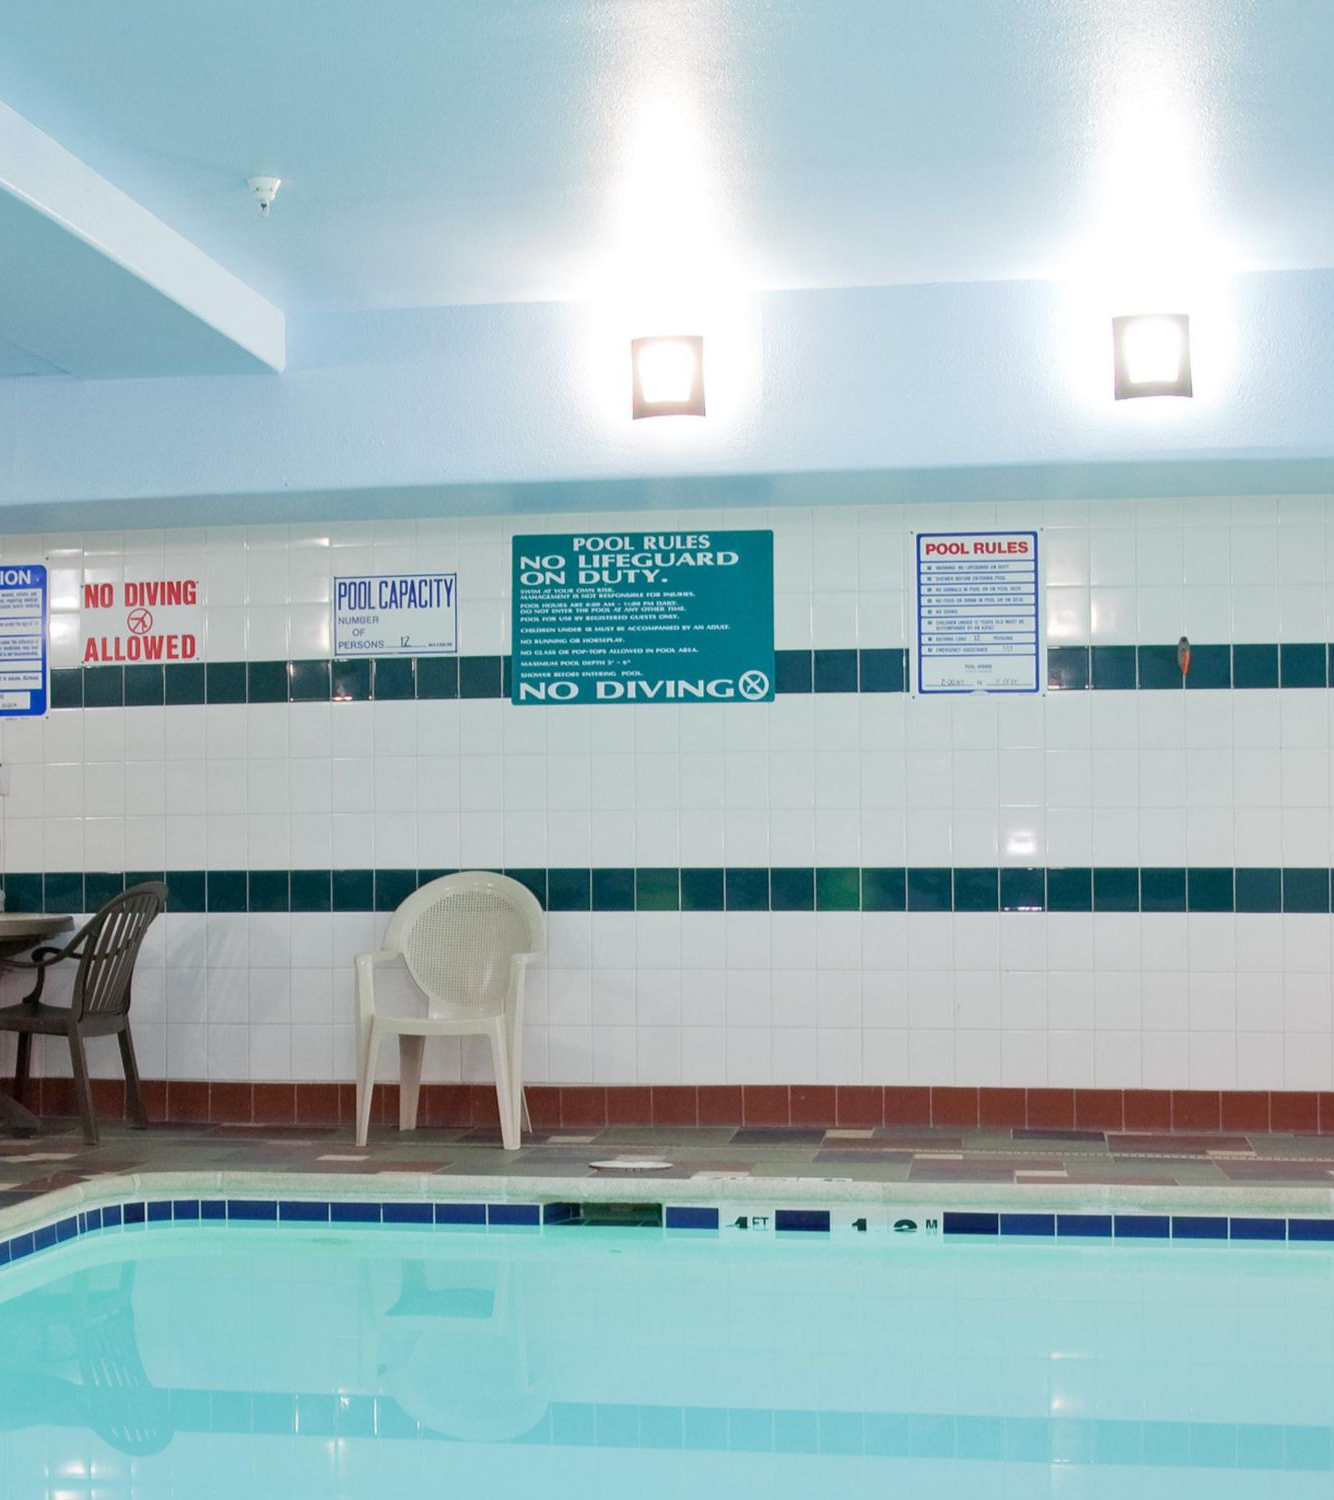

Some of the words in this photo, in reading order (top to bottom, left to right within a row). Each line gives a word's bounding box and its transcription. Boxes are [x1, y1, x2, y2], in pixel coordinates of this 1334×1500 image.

[573, 536, 635, 551] POOL
[643, 534, 710, 550] RULES
[926, 543, 969, 555] POOL
[974, 541, 1029, 554] RULES
[520, 555, 565, 570] NO
[579, 551, 739, 569] LIFEGUARD
[520, 571, 565, 586] ON
[579, 569, 667, 585] DUTY.
[85, 583, 113, 608] NO
[125, 580, 196, 607] DIVING
[338, 581, 376, 611] POOL
[379, 578, 453, 609] CAPACITY
[338, 616, 379, 625] NUMBER
[352, 628, 366, 637] OF
[84, 634, 196, 662] ALLOWED
[339, 640, 384, 649] PERSONS
[400, 636, 411, 648] 12
[520, 681, 579, 700] NO
[596, 679, 735, 699] DIVING
[752, 1216, 769, 1225] FT
